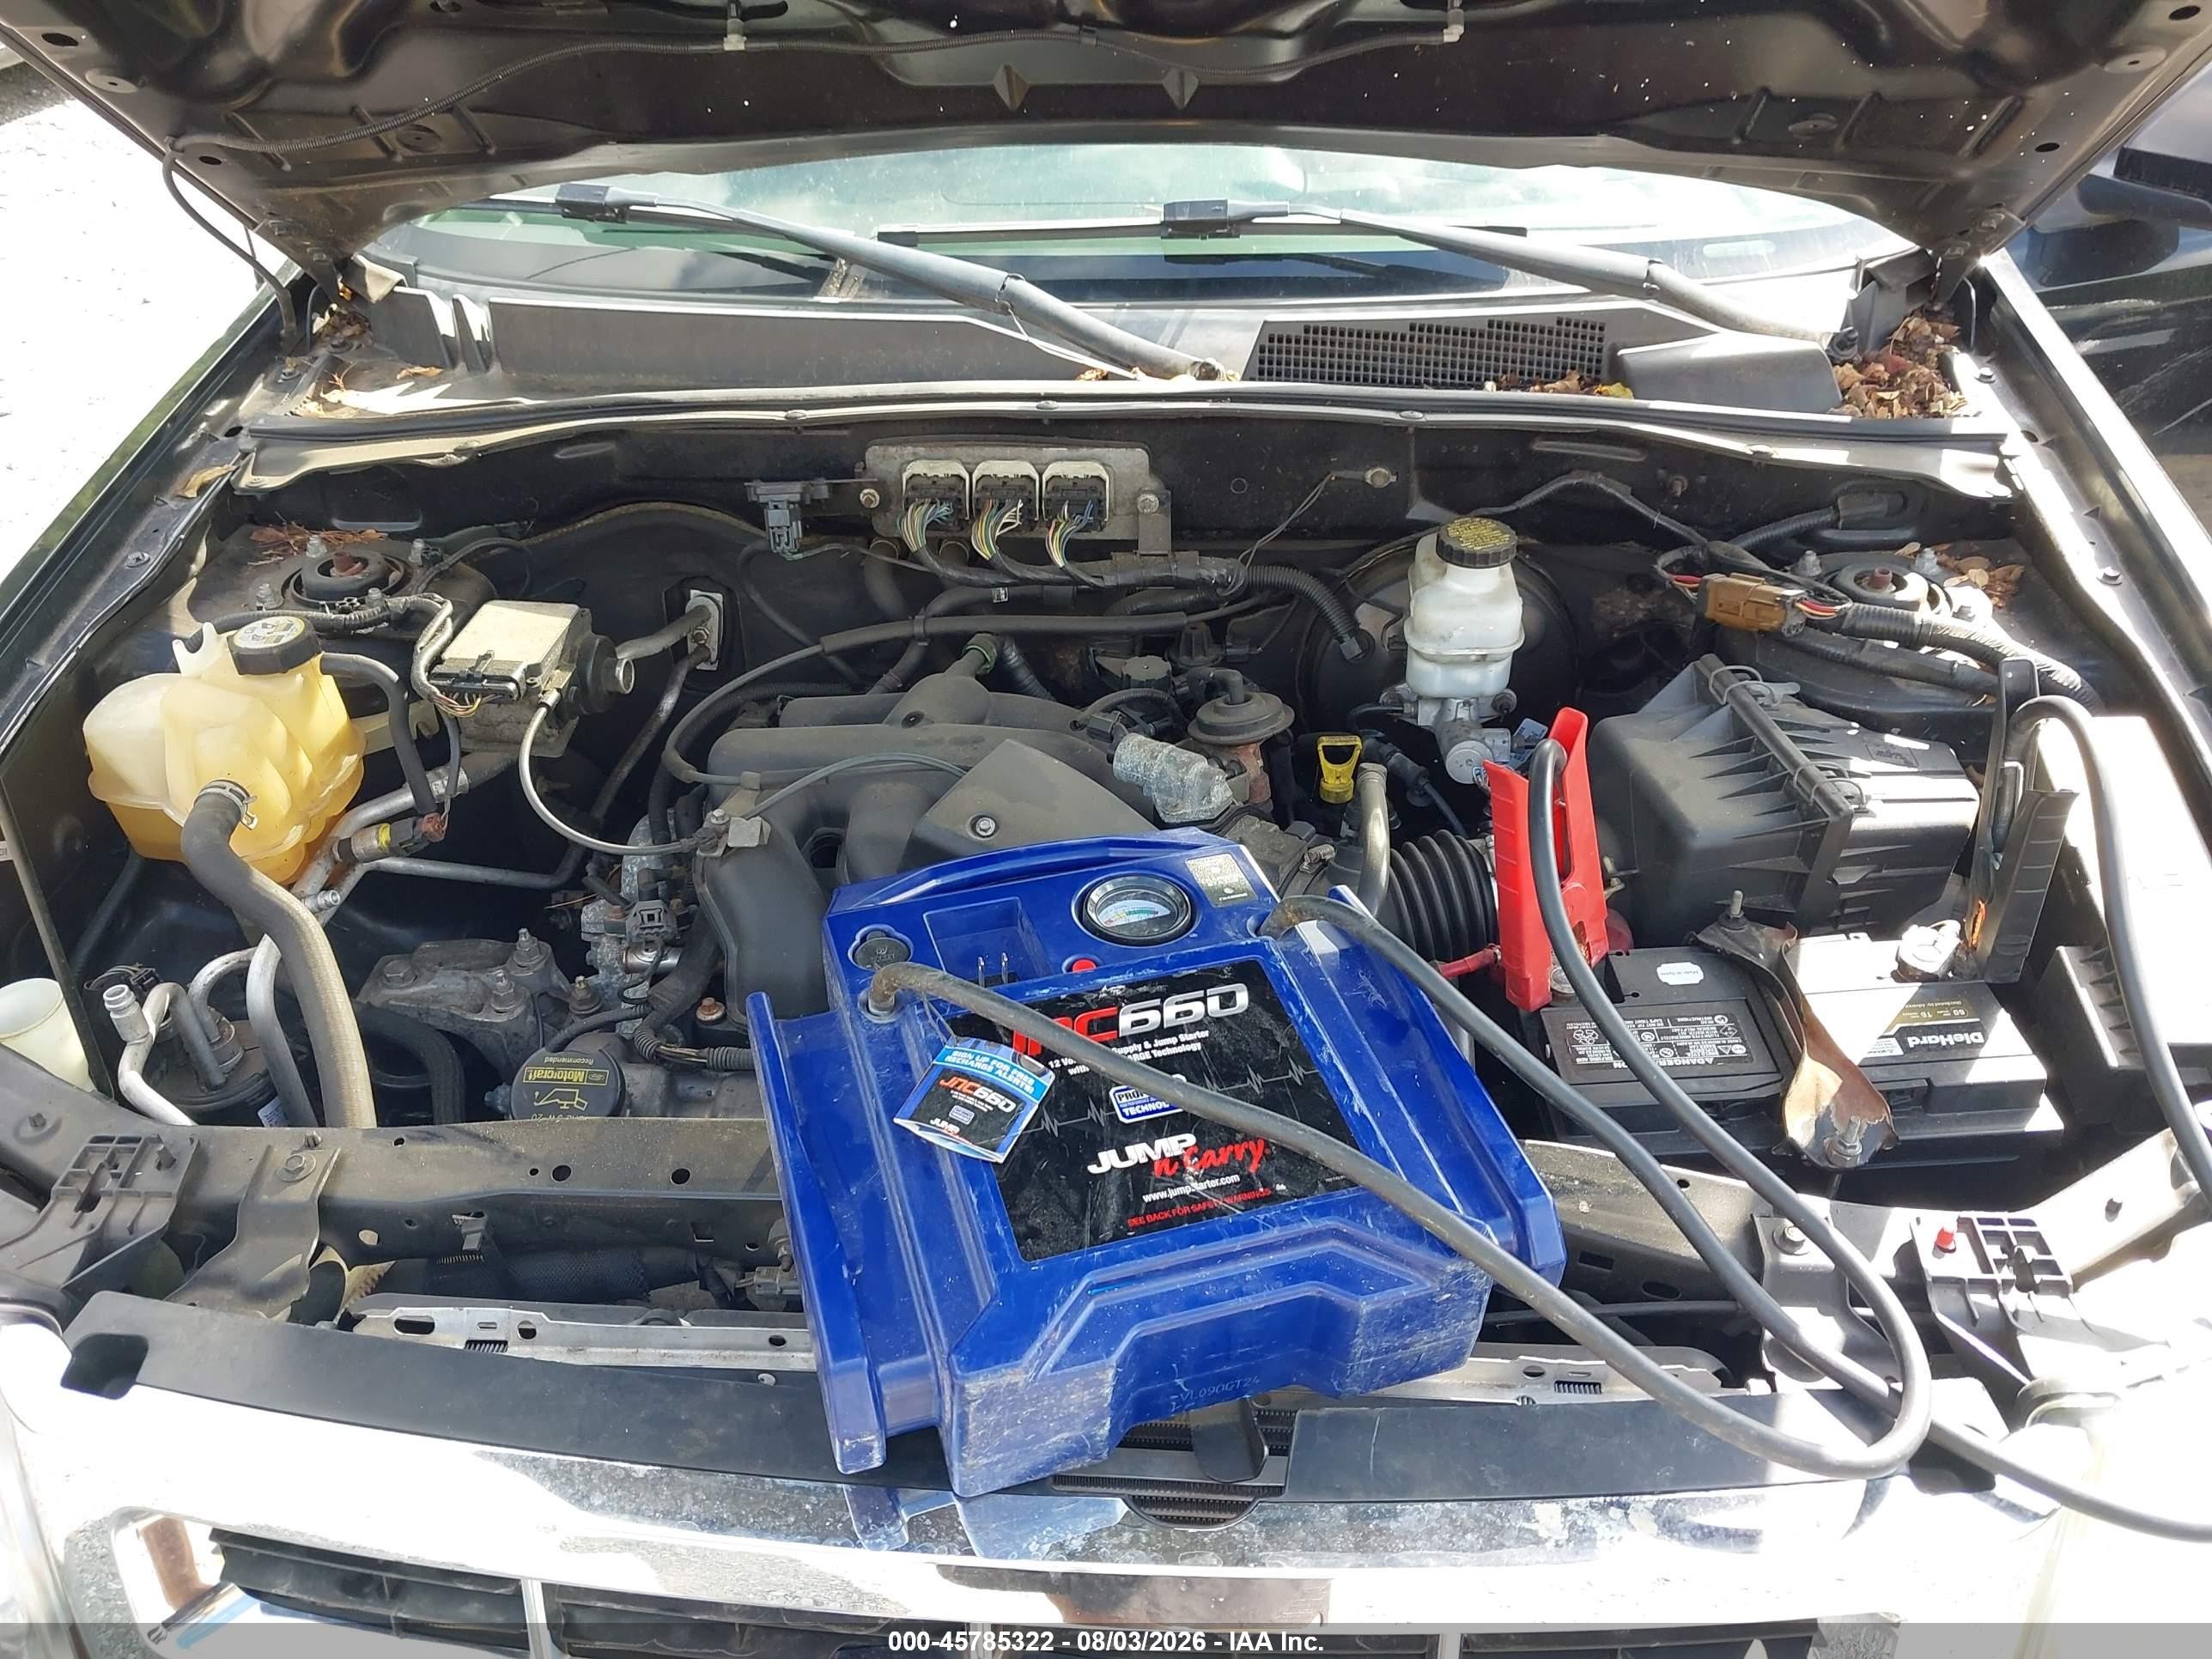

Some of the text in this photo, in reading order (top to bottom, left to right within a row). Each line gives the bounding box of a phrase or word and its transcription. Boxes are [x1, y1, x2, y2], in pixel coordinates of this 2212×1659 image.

[1048, 1059, 1061, 1069] 12
[1143, 1040, 1152, 1049] &
[1152, 1036, 1178, 1048] Jump
[1178, 1030, 1210, 1042] Starter
[1151, 1042, 1202, 1058] Technology
[1907, 1031, 1984, 1048] DieHard
[544, 1056, 594, 1066] Recommended
[945, 1055, 995, 1076] RECHARGE
[951, 1050, 975, 1061] SIGN
[975, 1054, 992, 1065] UP
[991, 1059, 1012, 1072] FOR
[527, 1069, 586, 1082] Motorcraft
[1086, 1133, 1197, 1175] JUMP
[1154, 1156, 1180, 1178] n
[1146, 1211, 1171, 1224] BACK
[1171, 1206, 1191, 1219] FOR
[1190, 1199, 1224, 1215] SAFETY
[1223, 1188, 1272, 1206] WARNINGS
